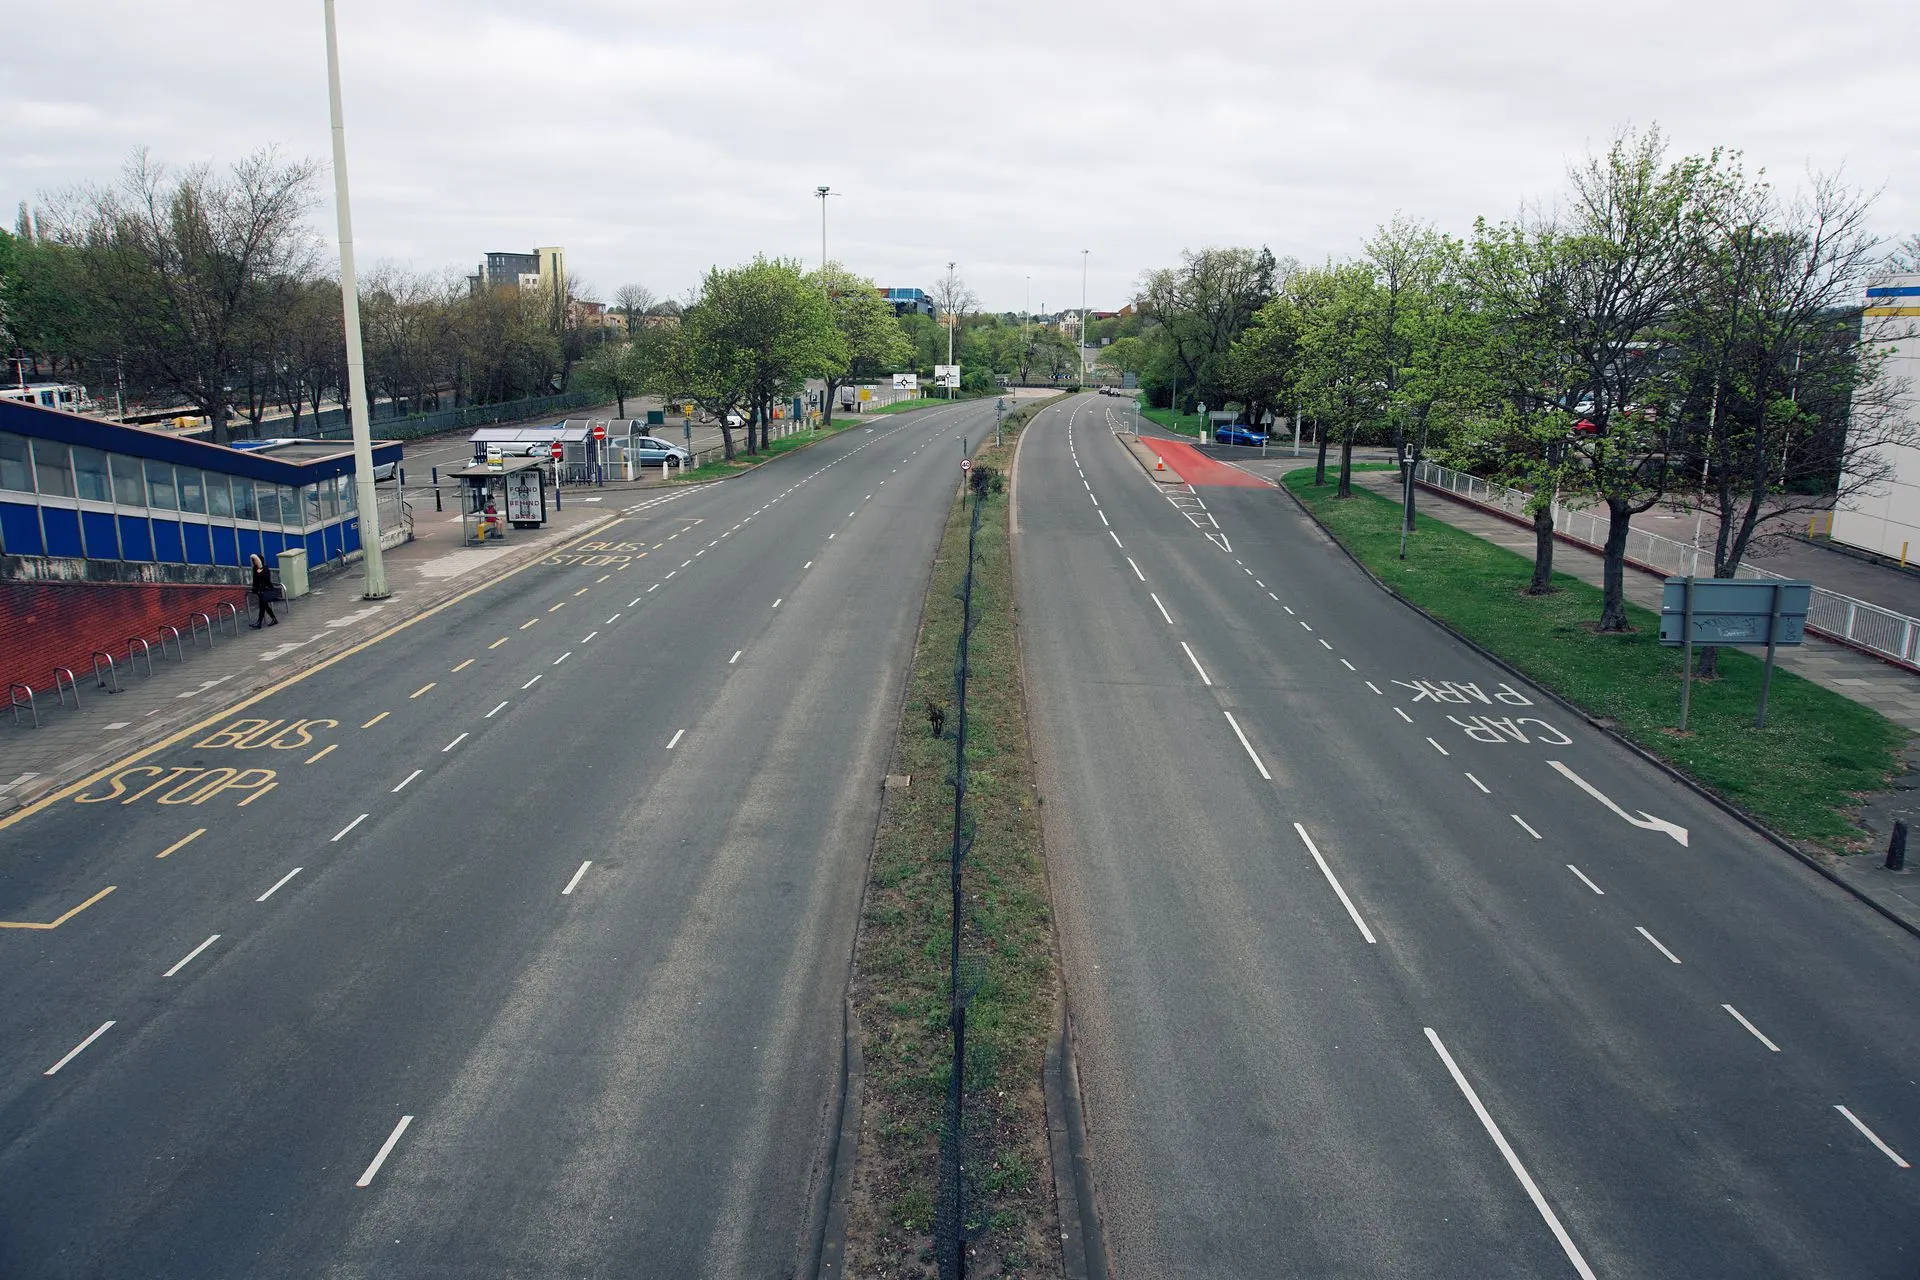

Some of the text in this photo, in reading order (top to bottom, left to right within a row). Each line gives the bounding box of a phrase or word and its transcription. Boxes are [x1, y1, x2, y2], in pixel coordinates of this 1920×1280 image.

[541, 555, 632, 566] STOP
[577, 542, 645, 552] BUS
[1390, 679, 1535, 706] PARK
[192, 718, 339, 750] BUS
[1445, 714, 1574, 746] CAR
[74, 765, 277, 805] STOP
